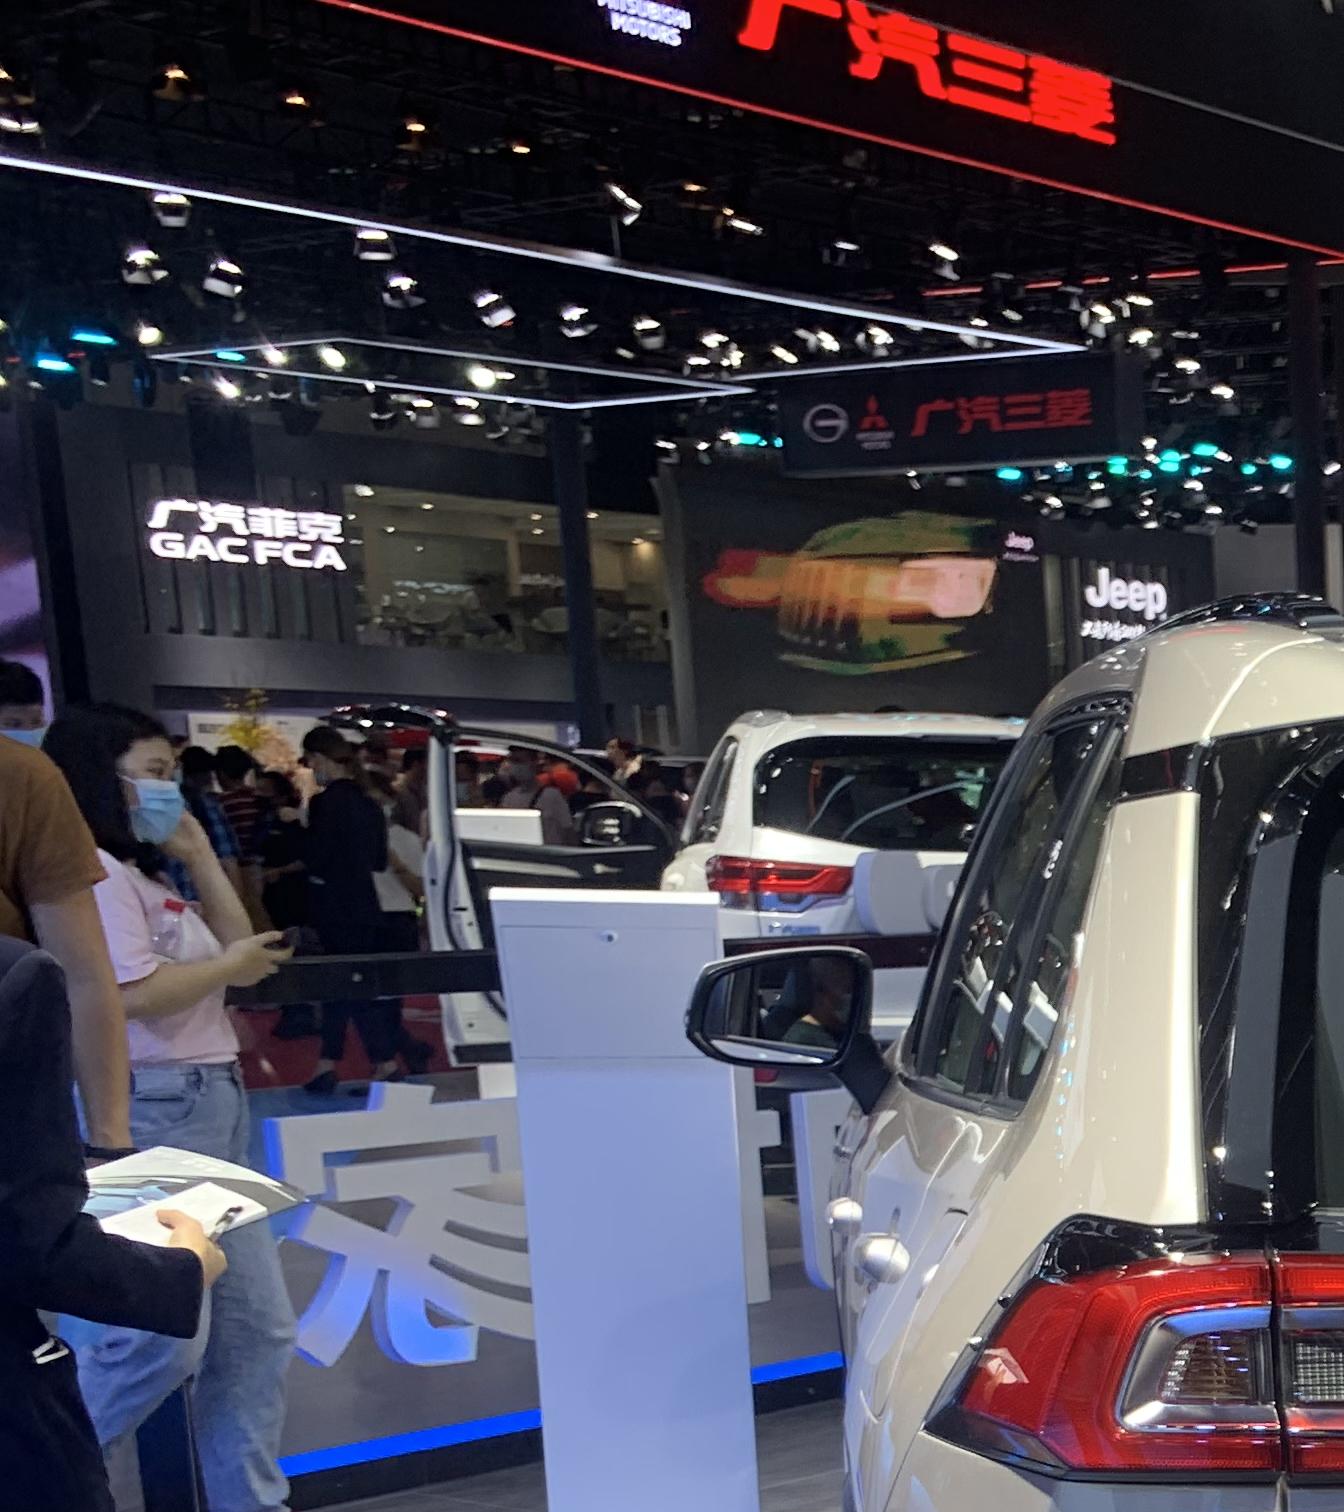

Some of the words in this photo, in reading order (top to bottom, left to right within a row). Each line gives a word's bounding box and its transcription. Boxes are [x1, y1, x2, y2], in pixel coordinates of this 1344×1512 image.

[911, 388, 1092, 437] 广汽三菱
[147, 499, 346, 544] 广汽菲克
[150, 532, 249, 564] GAC
[253, 540, 348, 571] FCA
[1084, 567, 1168, 620] Jeep
